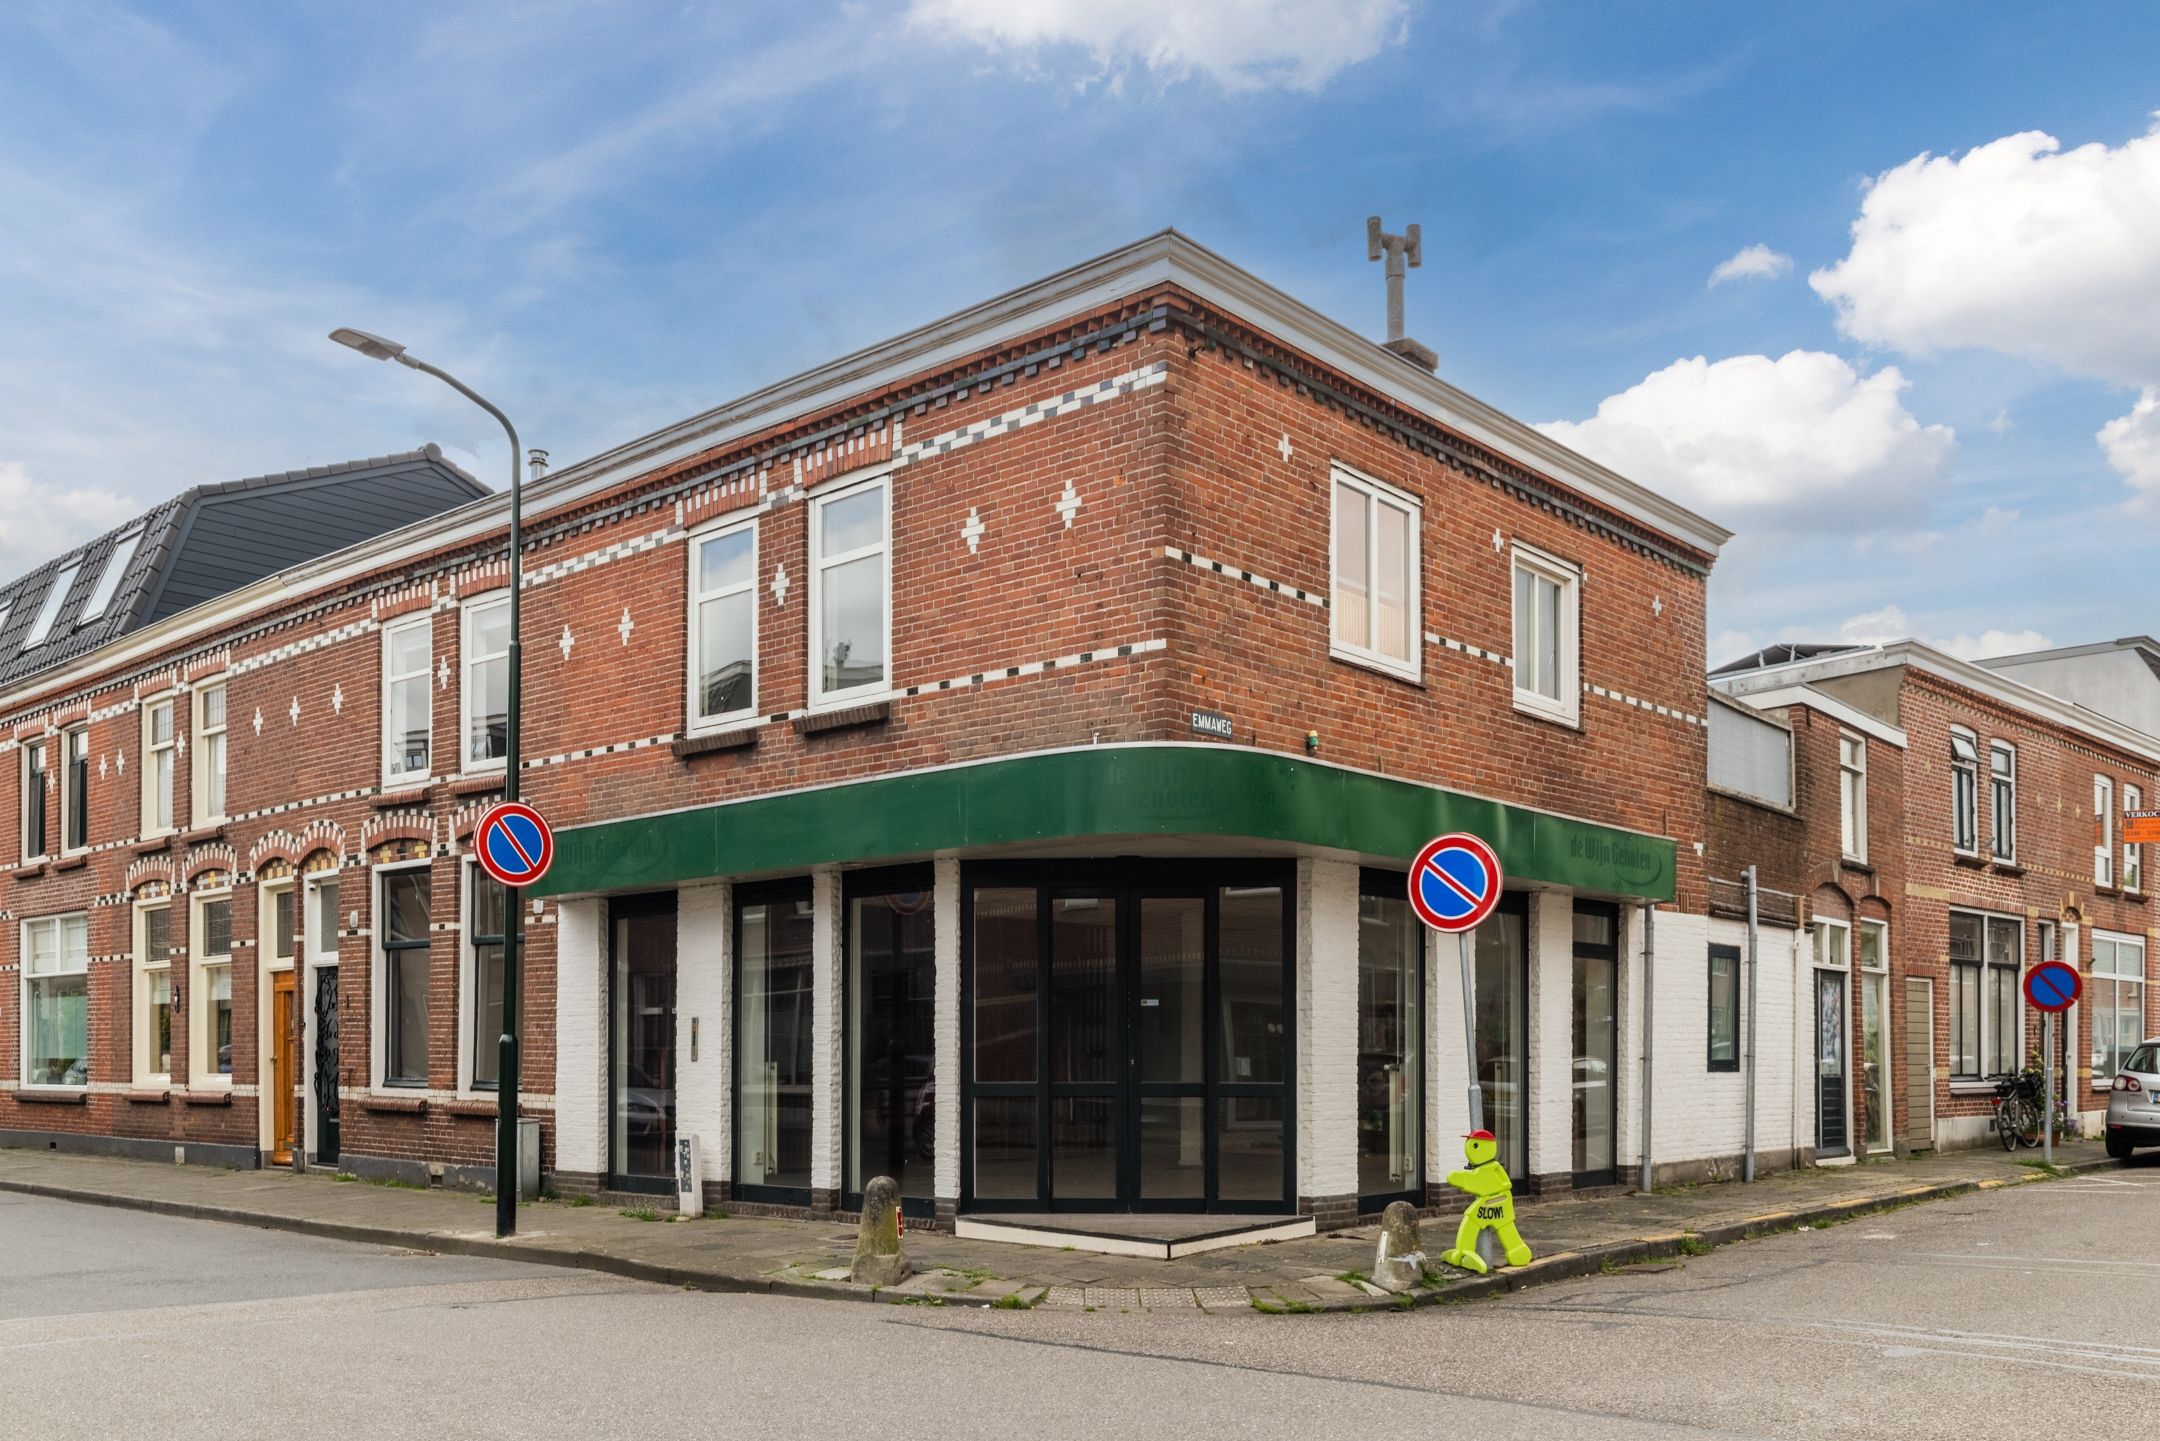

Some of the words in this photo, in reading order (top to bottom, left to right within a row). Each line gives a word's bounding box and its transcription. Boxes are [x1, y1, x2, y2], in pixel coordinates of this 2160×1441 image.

[1193, 713, 1232, 735] EMMAWEG
[1571, 834, 1583, 858] de
[1585, 836, 1610, 867] Wijn
[1612, 842, 1651, 871] Genoten
[1477, 1206, 1504, 1219] SLOW!
